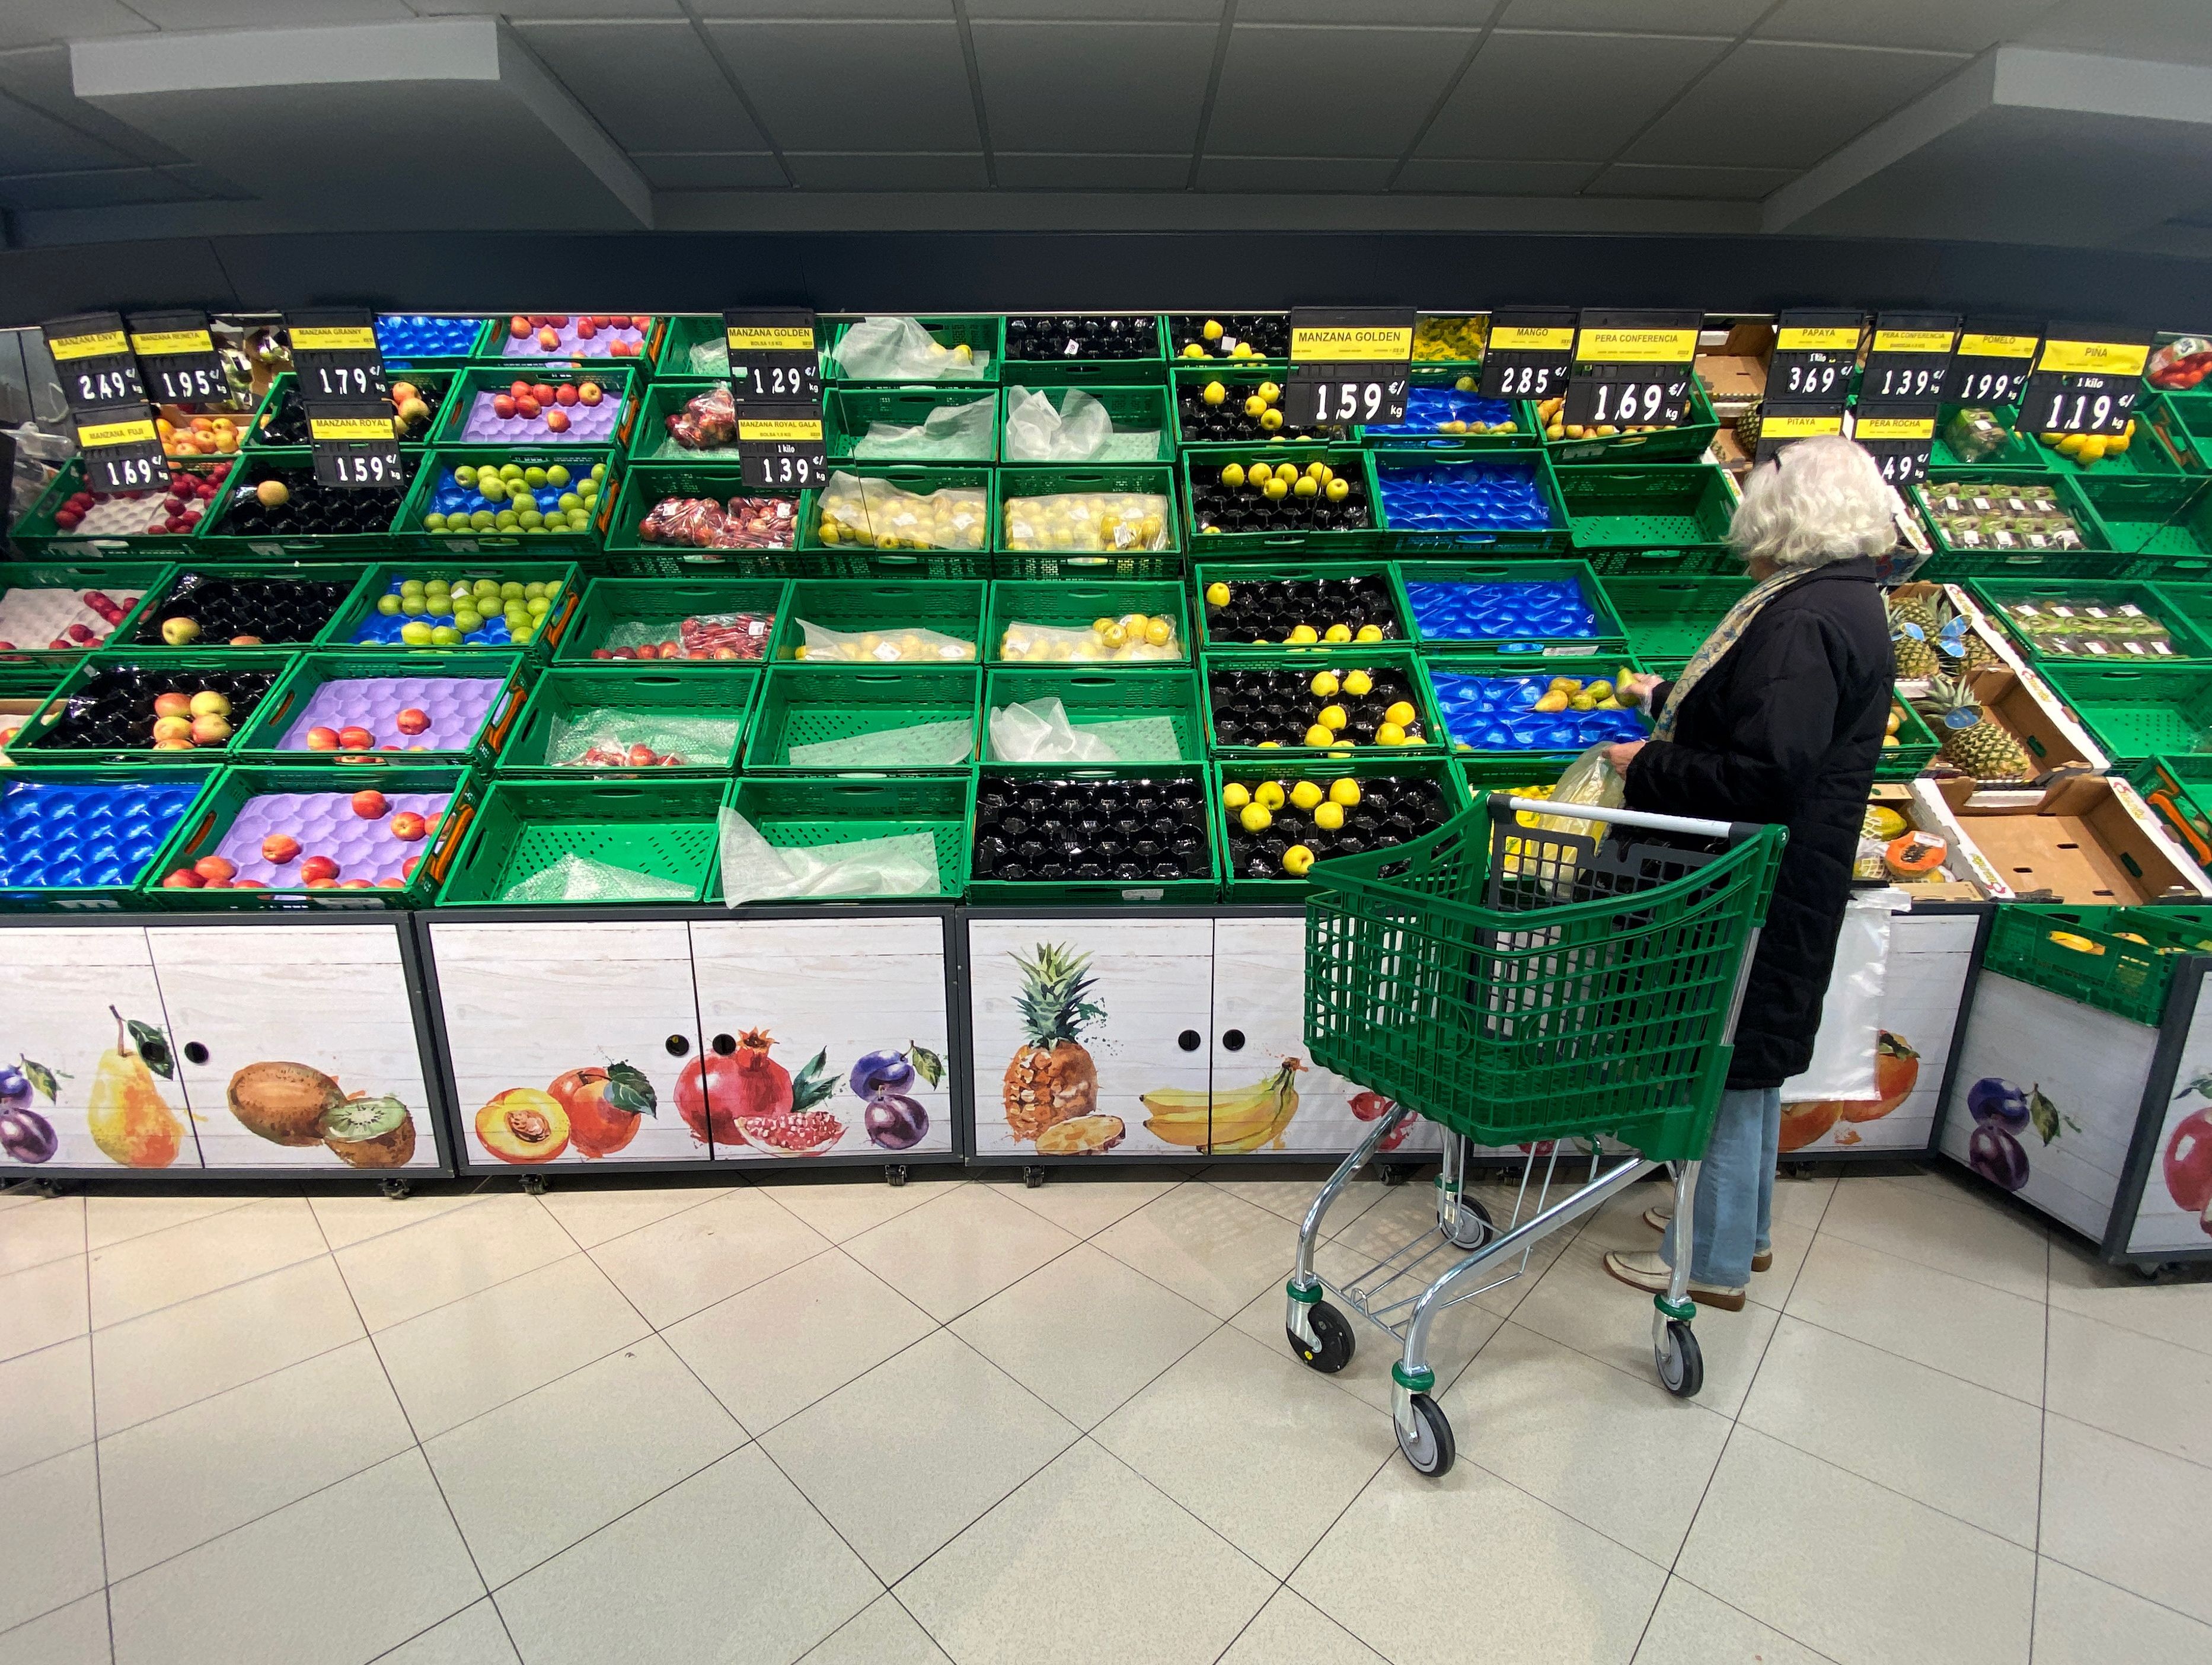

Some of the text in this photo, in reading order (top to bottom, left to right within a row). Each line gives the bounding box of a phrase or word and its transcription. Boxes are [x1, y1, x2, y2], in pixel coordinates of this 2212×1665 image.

[729, 328, 810, 337] MANZANA GOLDEN
[1298, 331, 1401, 342] MANZANA GOLDEN
[58, 332, 118, 346] MANZANA ENVY
[1619, 334, 1678, 343] CONFERENCIA
[1983, 335, 2016, 345] POMELO
[809, 383, 819, 393] kg
[2077, 377, 2104, 389] 1 kilo
[1390, 404, 1403, 418] kg
[1665, 407, 1678, 421] kg
[316, 419, 358, 427] MANZANA
[2111, 416, 2124, 430] kg
[89, 428, 145, 440] MANZANA FUJI
[783, 444, 796, 454] kilo
[816, 471, 826, 481] kg
